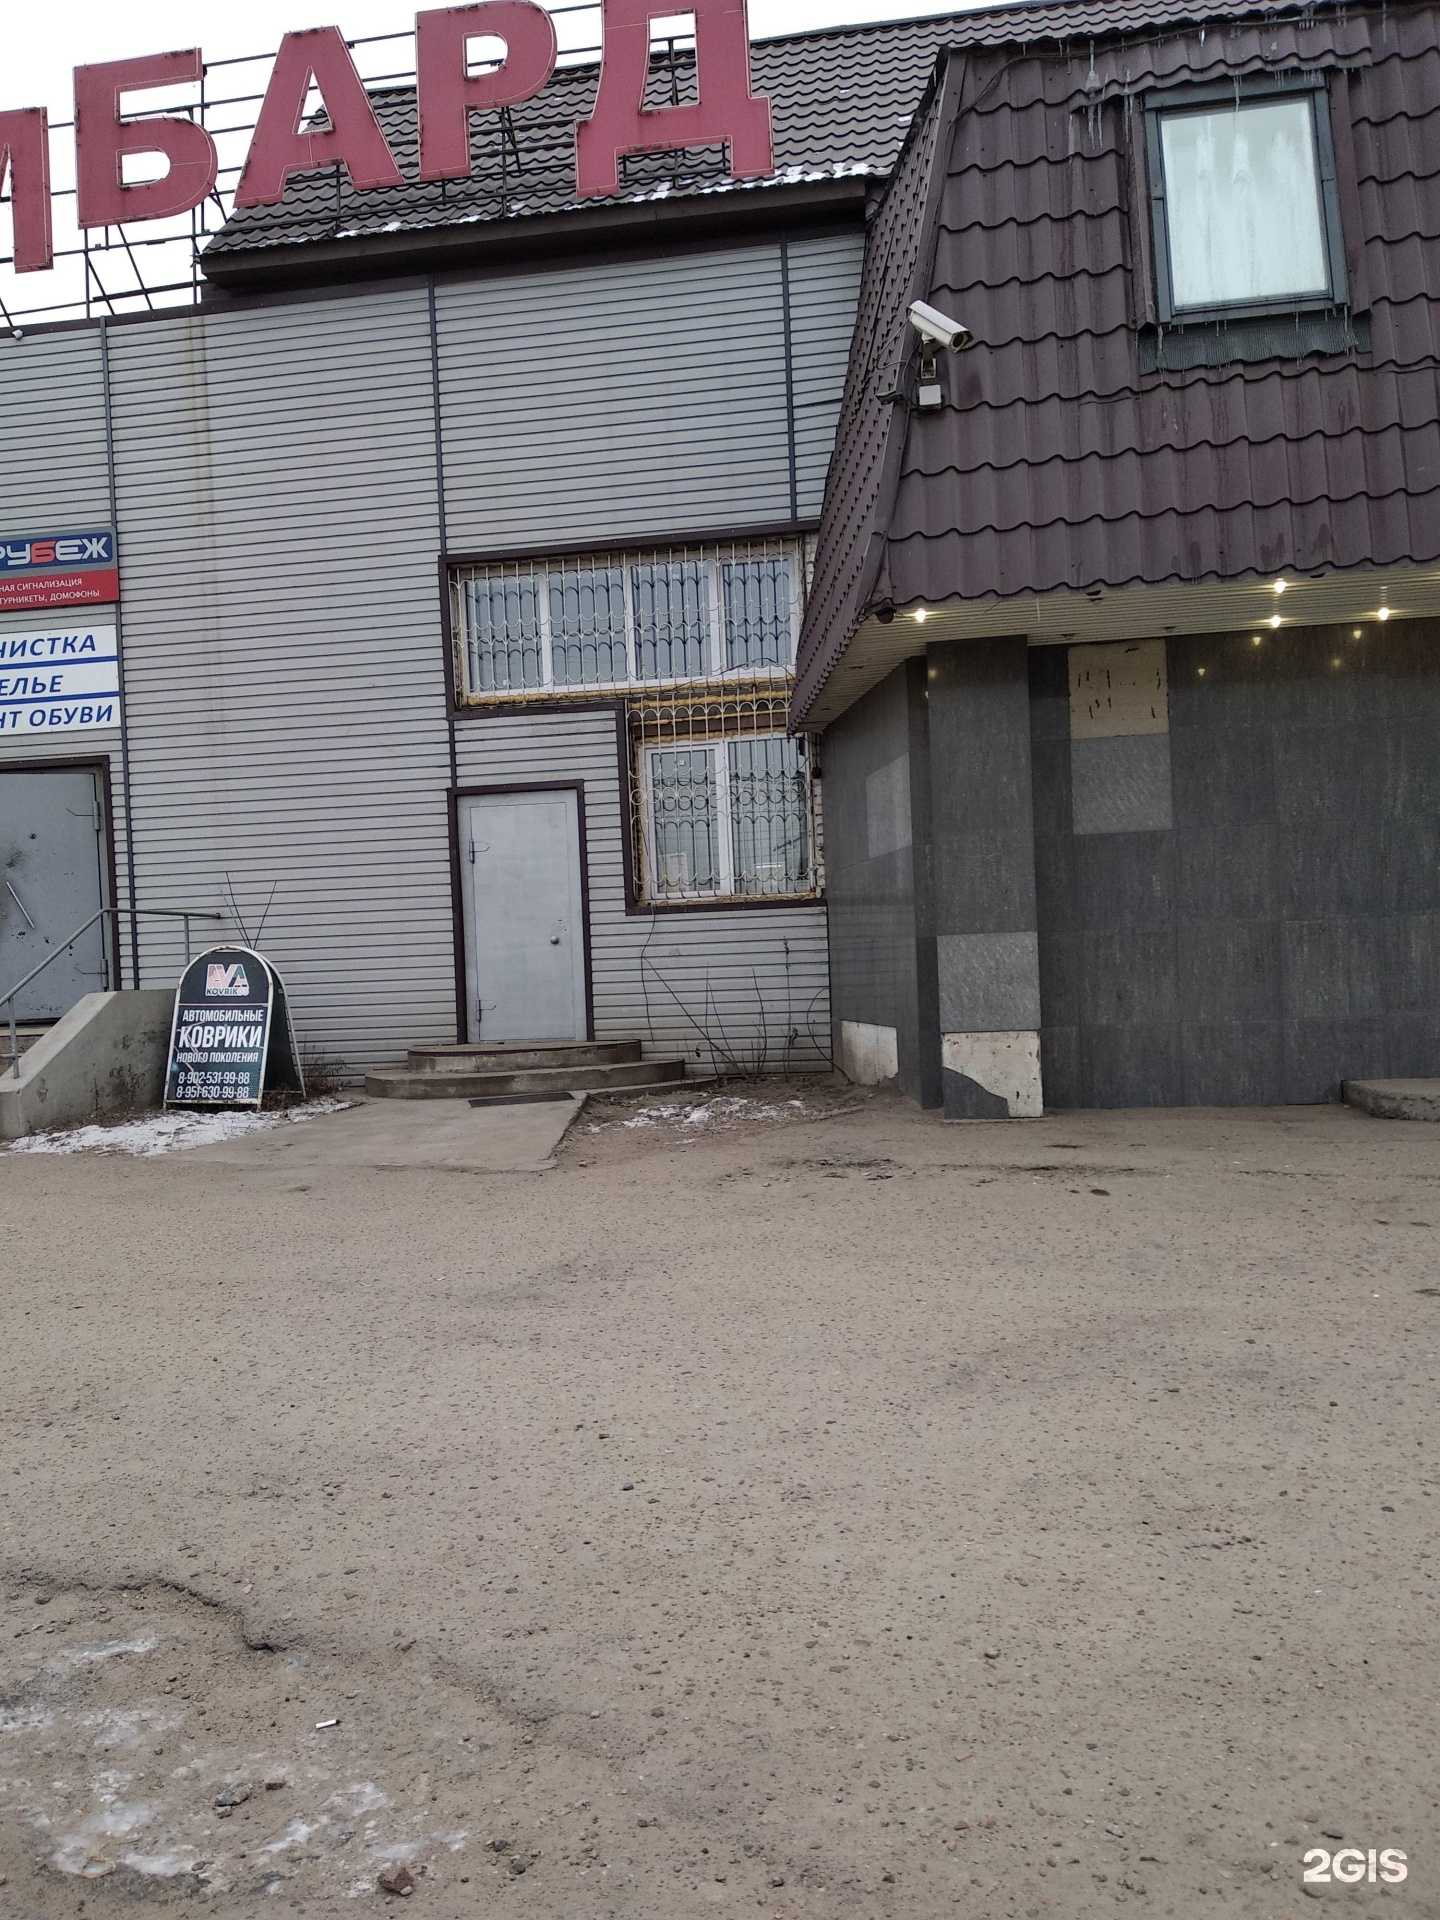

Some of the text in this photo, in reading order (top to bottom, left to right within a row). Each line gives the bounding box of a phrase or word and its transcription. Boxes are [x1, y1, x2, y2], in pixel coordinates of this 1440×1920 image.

[0, 536, 109, 566] УБЕЖ
[16, 577, 83, 592] СИГНАЛИЗАЦИЯ
[49, 589, 101, 601] ДОМОФОНЫ
[29, 704, 113, 727] ОБУВИ
[182, 1009, 265, 1022] АВТОМОБИЛЬНЫЕ
[178, 1025, 263, 1048] КОВРИКИ
[176, 1052, 259, 1063] НОВОГО ПОКОЛЕНИЯ
[178, 1071, 250, 1085] 8-902-531-99-88
